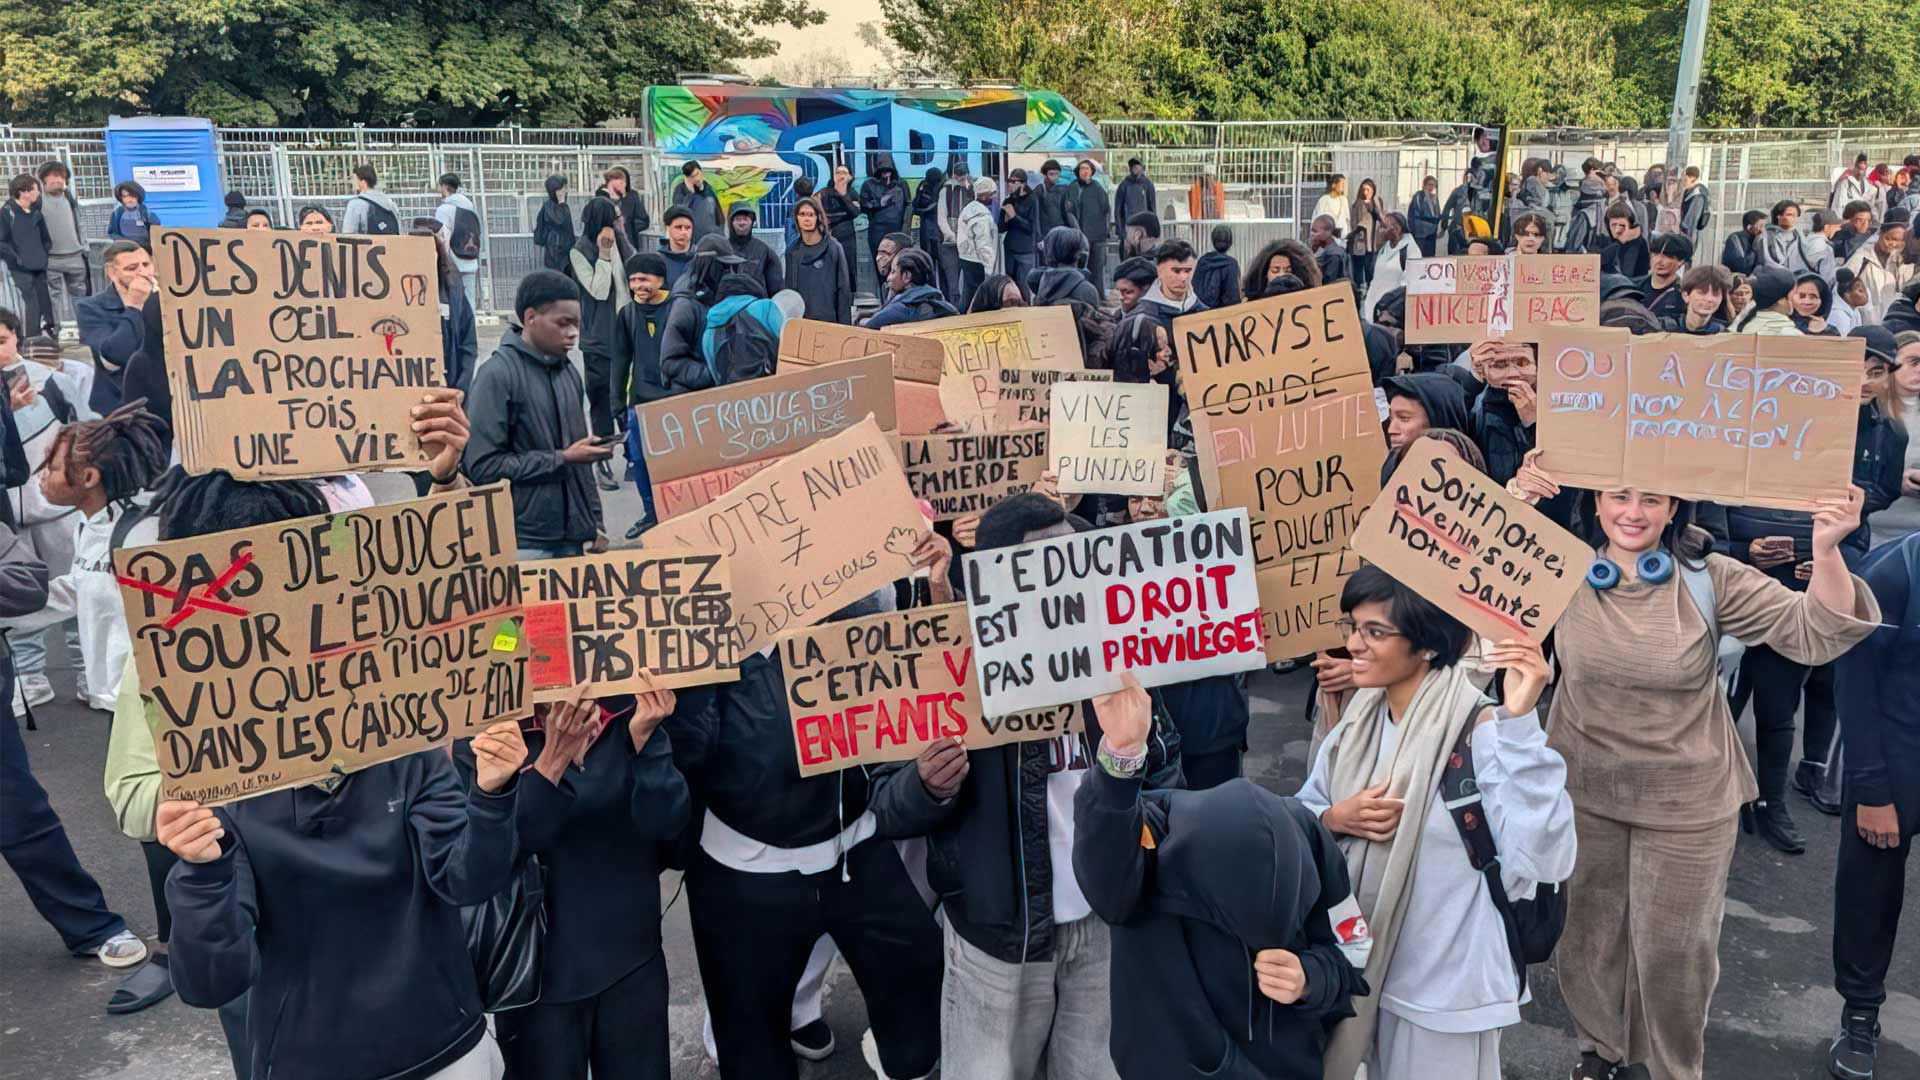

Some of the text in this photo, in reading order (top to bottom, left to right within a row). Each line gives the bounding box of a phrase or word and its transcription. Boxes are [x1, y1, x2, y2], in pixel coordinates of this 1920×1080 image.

[161, 231, 391, 299] DES DENTS
[176, 306, 235, 349] UN
[1186, 298, 1345, 373] MARYSE
[1528, 296, 1585, 324] BAC
[184, 354, 256, 401] LA
[1202, 358, 1338, 417] CONDÉ
[278, 396, 357, 431] FOIS
[640, 408, 685, 457] LA
[692, 391, 804, 447] FRANCE
[1060, 394, 1132, 422] VIVE
[1212, 392, 1375, 467] EN LUTTE
[233, 424, 405, 469] UNE VIE
[905, 431, 1046, 467] LA JEUNESSE
[1091, 427, 1128, 449] LES
[802, 444, 886, 511] AVENIR
[1058, 455, 1155, 485] PUNJABI
[1254, 454, 1354, 512] POUR
[127, 488, 503, 618] PAS DE BUDGET
[968, 518, 1246, 607] L'EDUCATION
[1290, 551, 1331, 588] ET
[568, 598, 639, 632] LES
[754, 550, 879, 634] DÉCISIONS
[976, 563, 1237, 648] EST UN DROIT
[137, 612, 290, 678] POUR
[571, 631, 635, 685] PAS
[788, 636, 826, 669] LA
[983, 653, 1035, 697] PAS
[1048, 646, 1094, 683] UN
[152, 678, 236, 728] VU
[250, 661, 336, 712] QUE
[383, 623, 488, 679] PIQUE
[163, 719, 267, 779] DANS
[278, 708, 336, 762] LES
[342, 687, 449, 754] CAISSES
[446, 664, 477, 700] DE
[796, 692, 969, 766] ENFANTS
